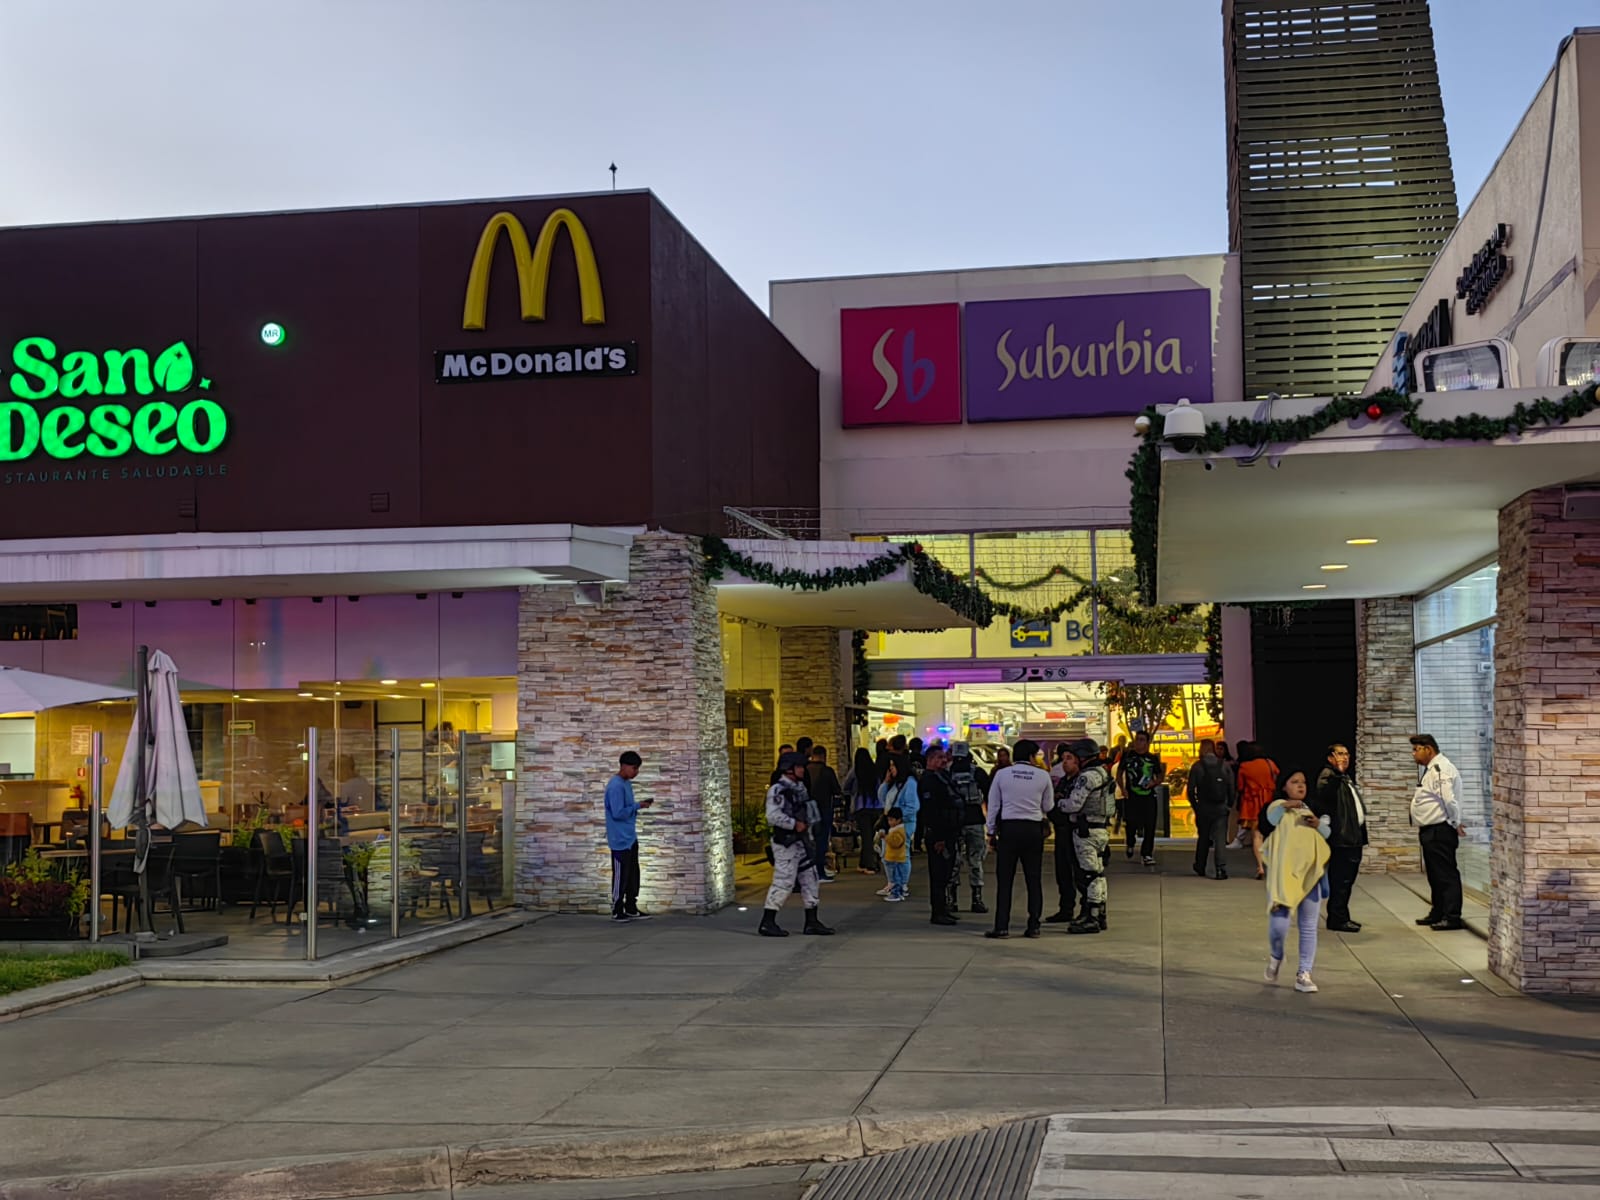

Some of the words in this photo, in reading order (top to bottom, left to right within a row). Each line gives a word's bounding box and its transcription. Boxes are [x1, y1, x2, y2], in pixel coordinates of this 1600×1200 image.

[442, 347, 627, 378] McDonald's
[996, 320, 1183, 391] Suburbia
[0, 399, 228, 461] Deseo
[121, 465, 228, 480] SALUDABLE
